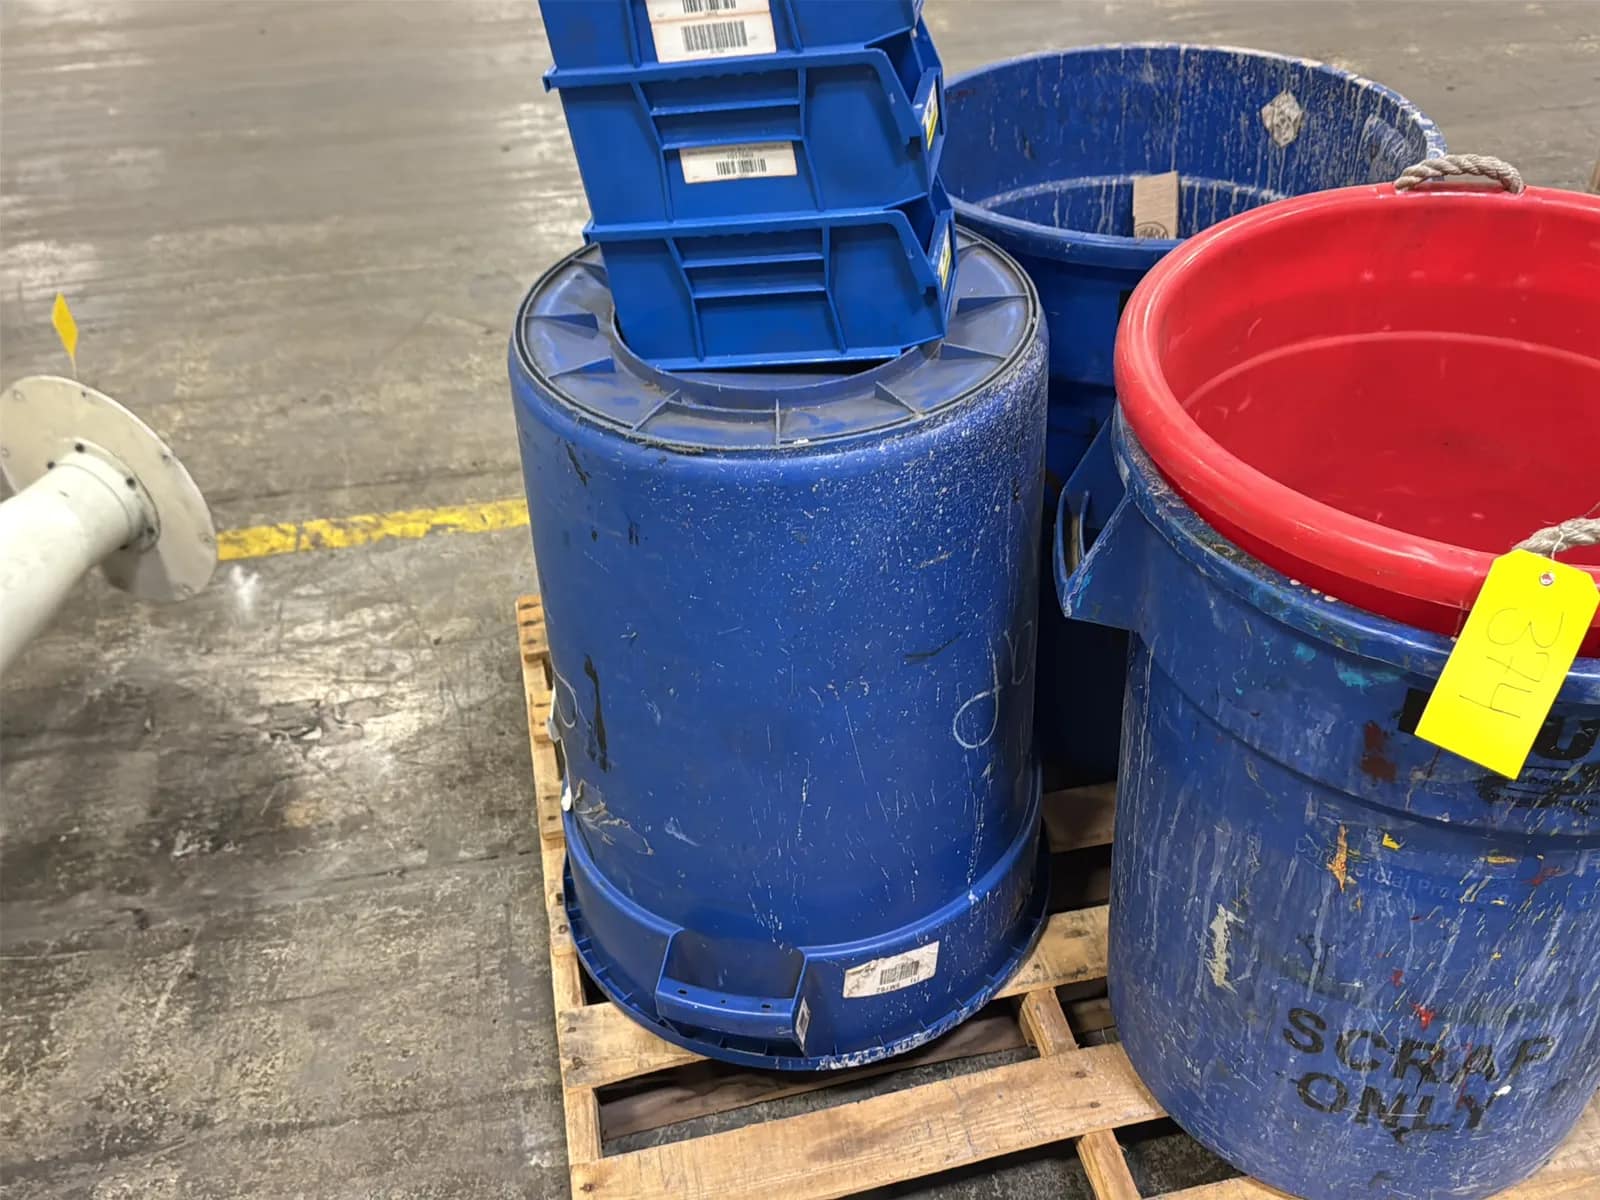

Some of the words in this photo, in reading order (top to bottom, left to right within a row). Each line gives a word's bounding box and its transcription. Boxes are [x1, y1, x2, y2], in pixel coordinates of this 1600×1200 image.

[1458, 607, 1565, 719] 374
[1282, 1007, 1555, 1083] SCRAP
[1290, 1071, 1512, 1130] ONLY
